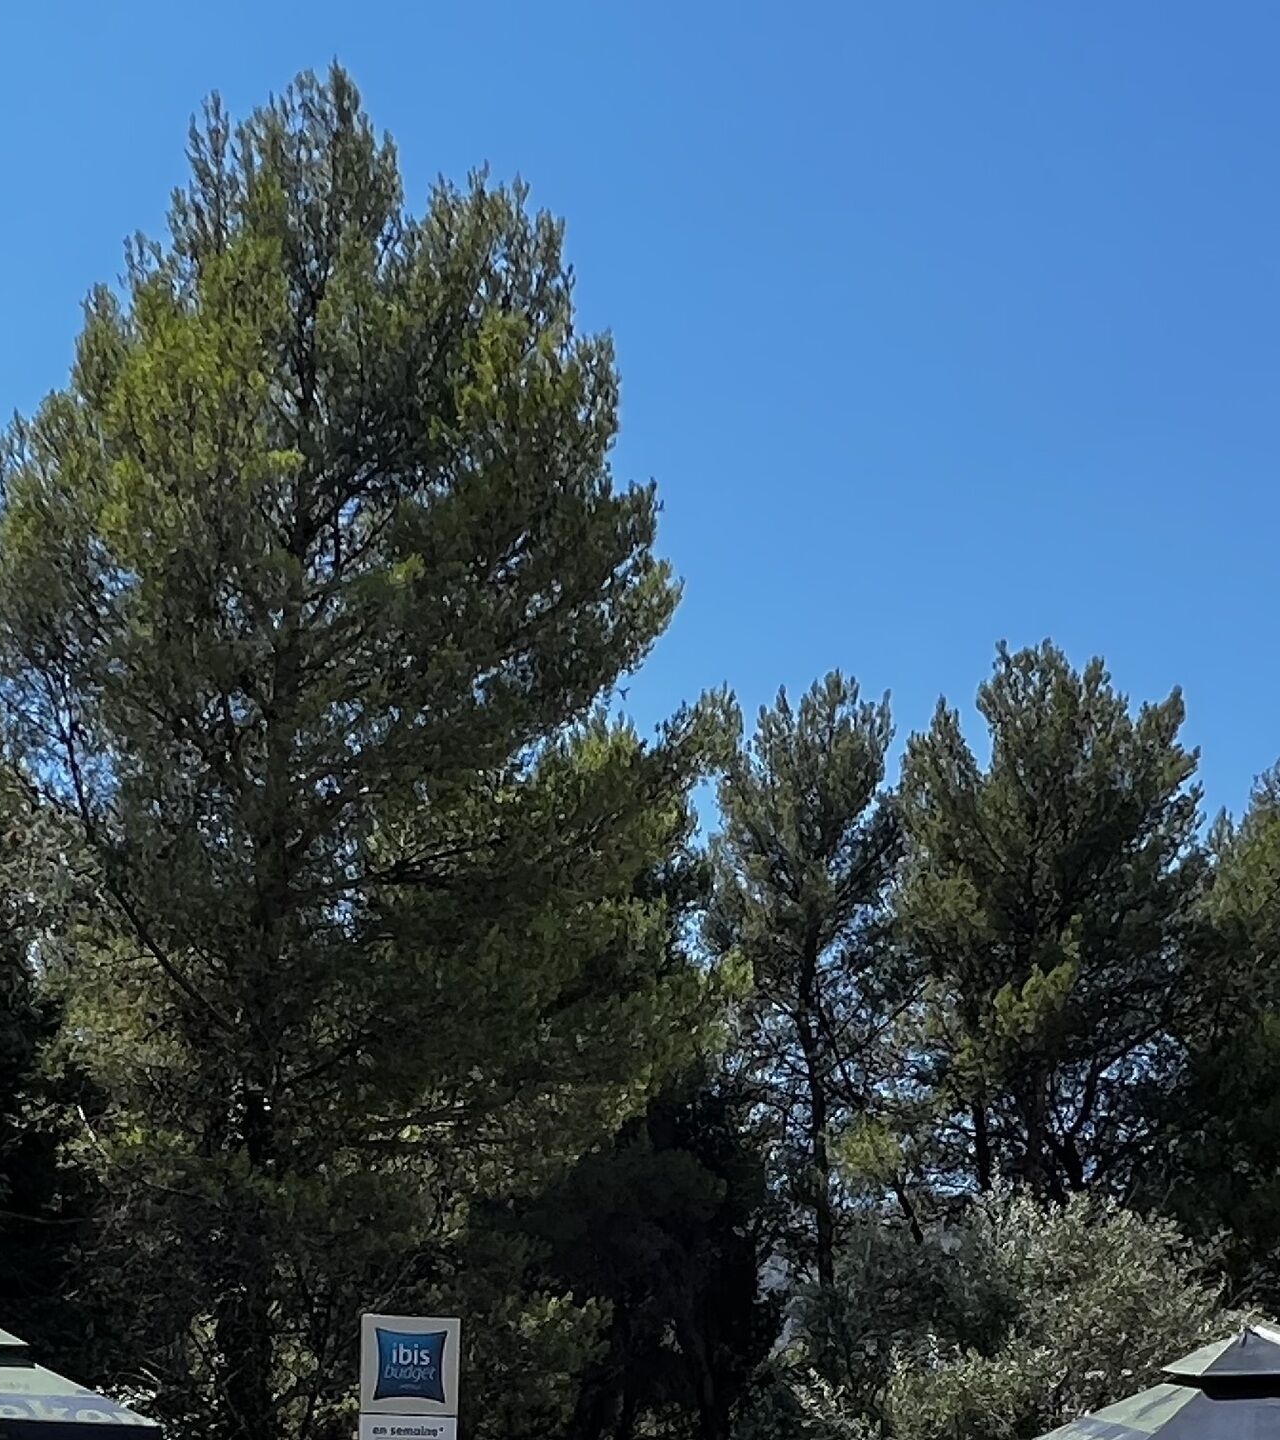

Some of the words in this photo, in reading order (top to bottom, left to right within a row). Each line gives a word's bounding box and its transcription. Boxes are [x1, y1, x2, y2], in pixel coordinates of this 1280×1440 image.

[392, 1343, 430, 1365] ibis
[384, 1363, 436, 1382] budget
[372, 1426, 387, 1435] en
